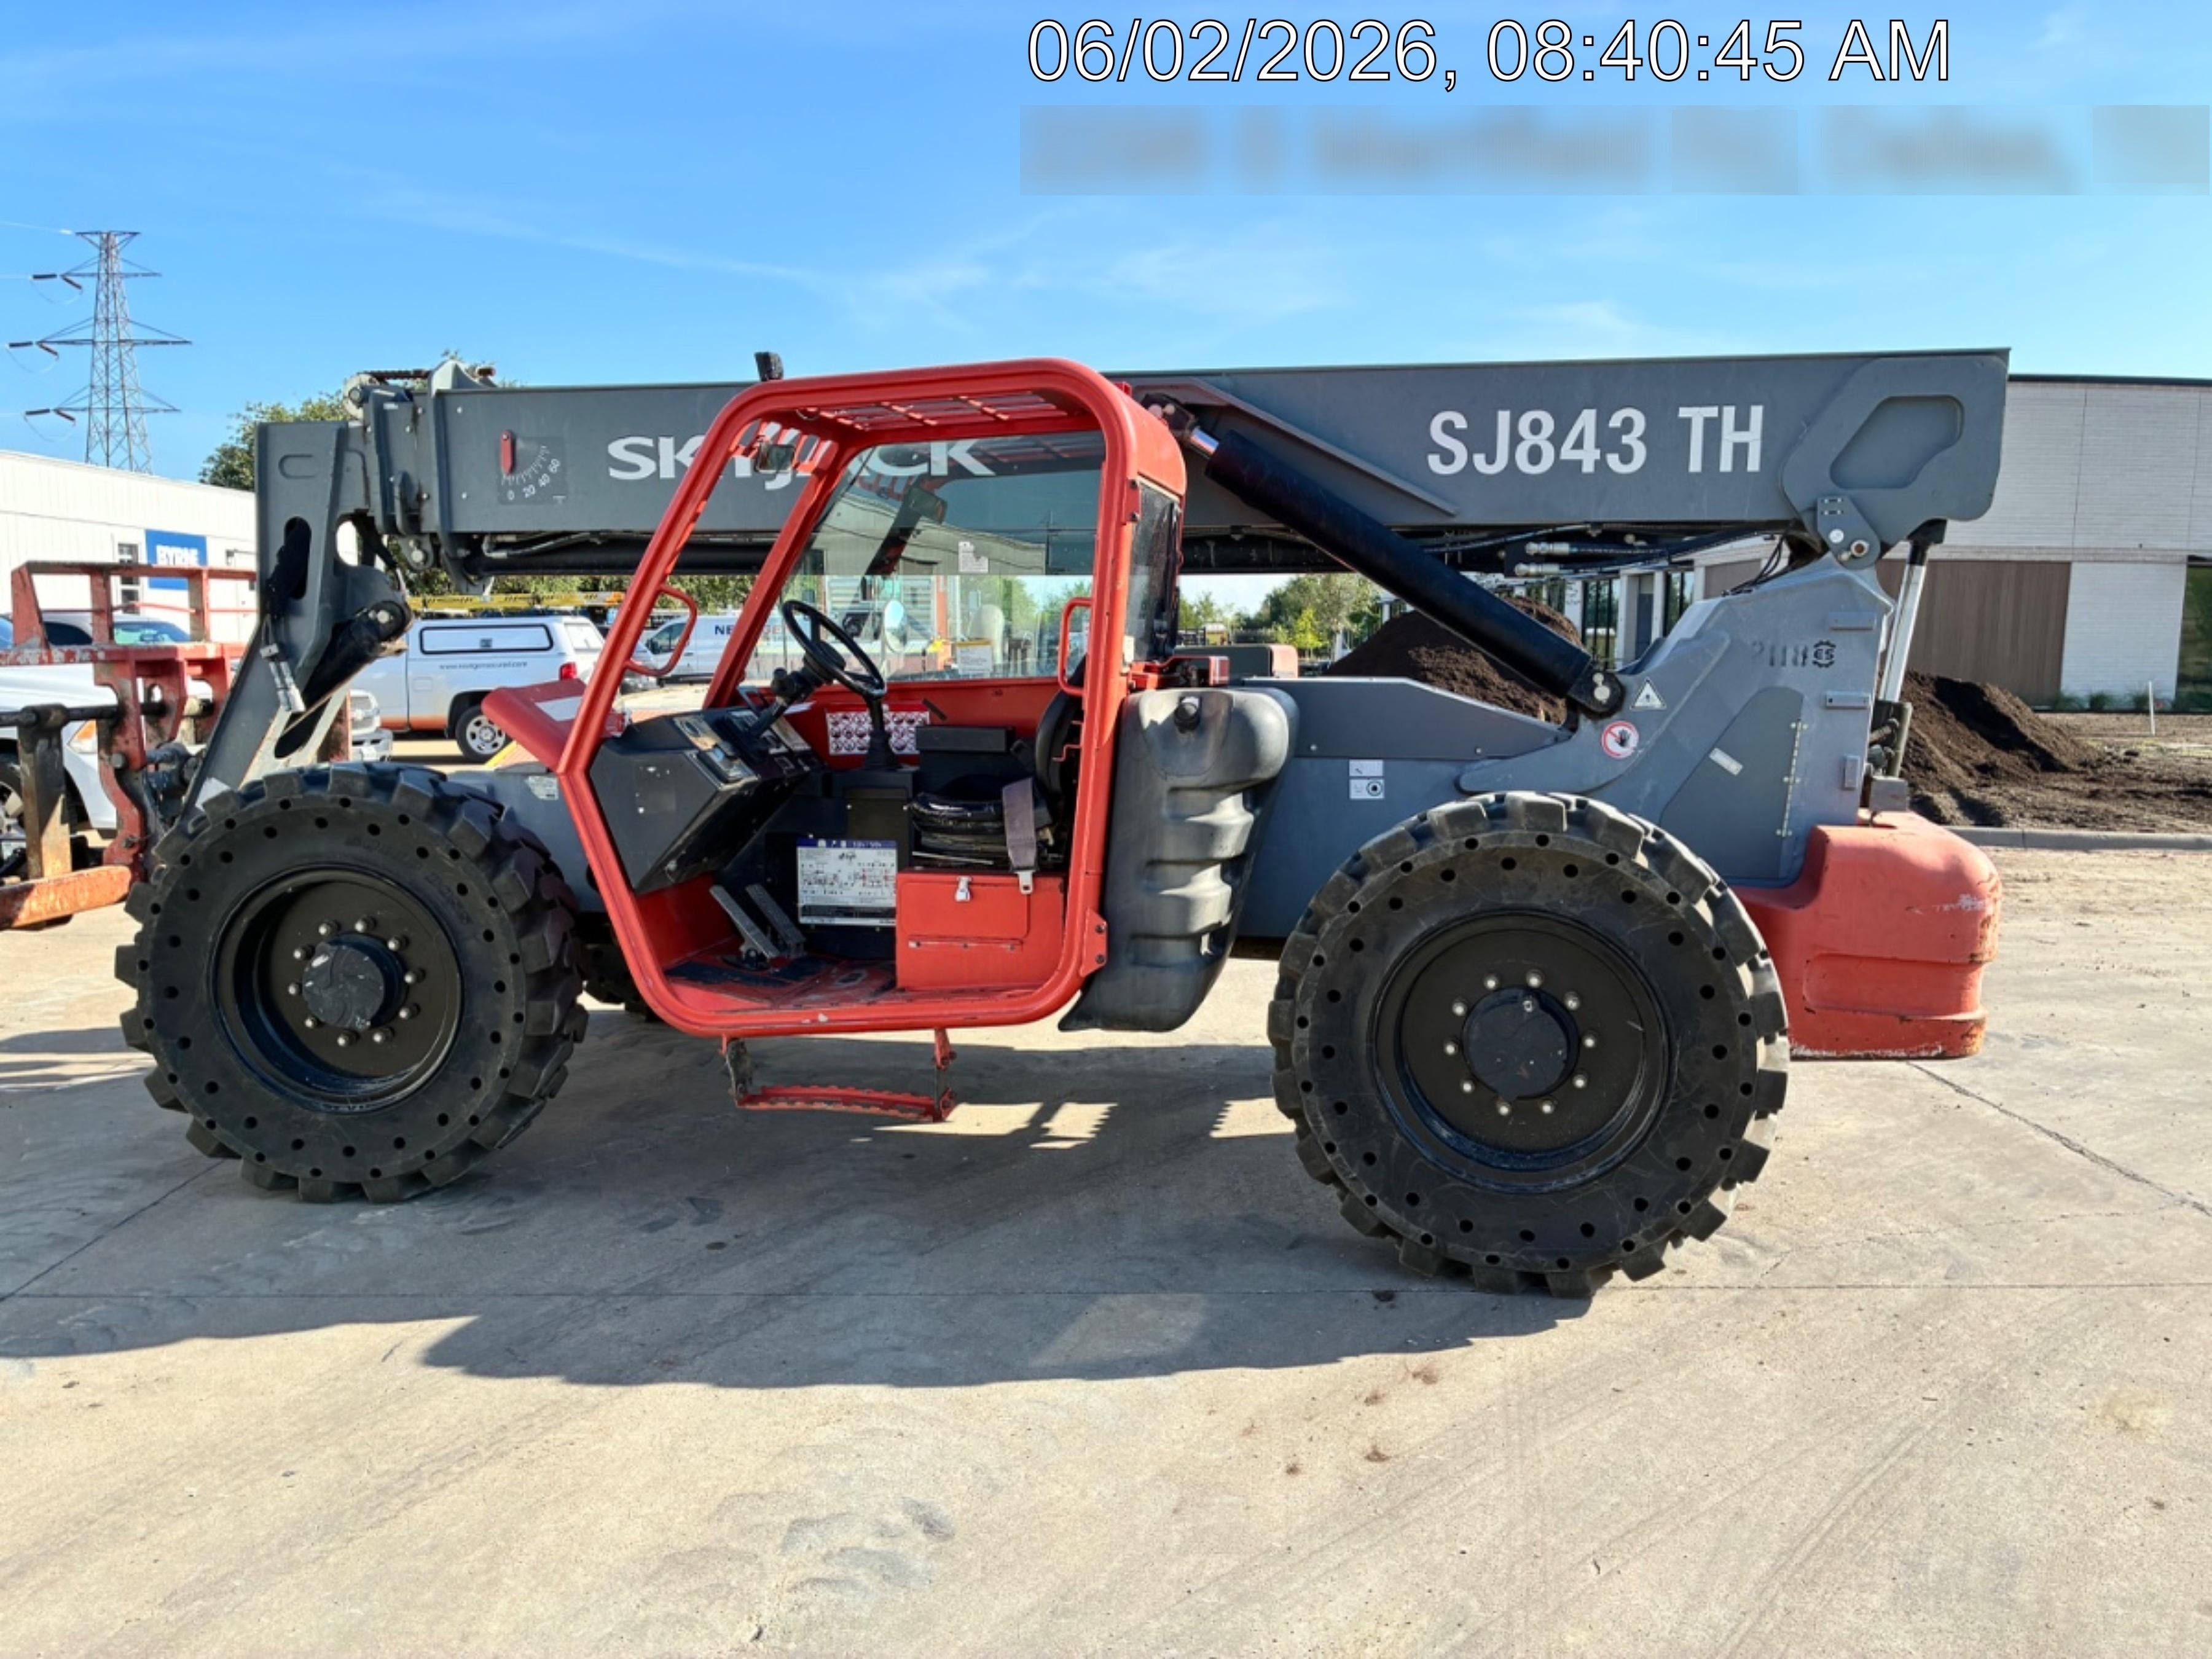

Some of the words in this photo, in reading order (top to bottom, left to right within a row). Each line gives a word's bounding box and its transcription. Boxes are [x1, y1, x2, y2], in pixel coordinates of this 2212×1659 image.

[1427, 407, 1647, 475] SJ843
[1677, 405, 1765, 473] TH
[523, 484, 536, 498] 20
